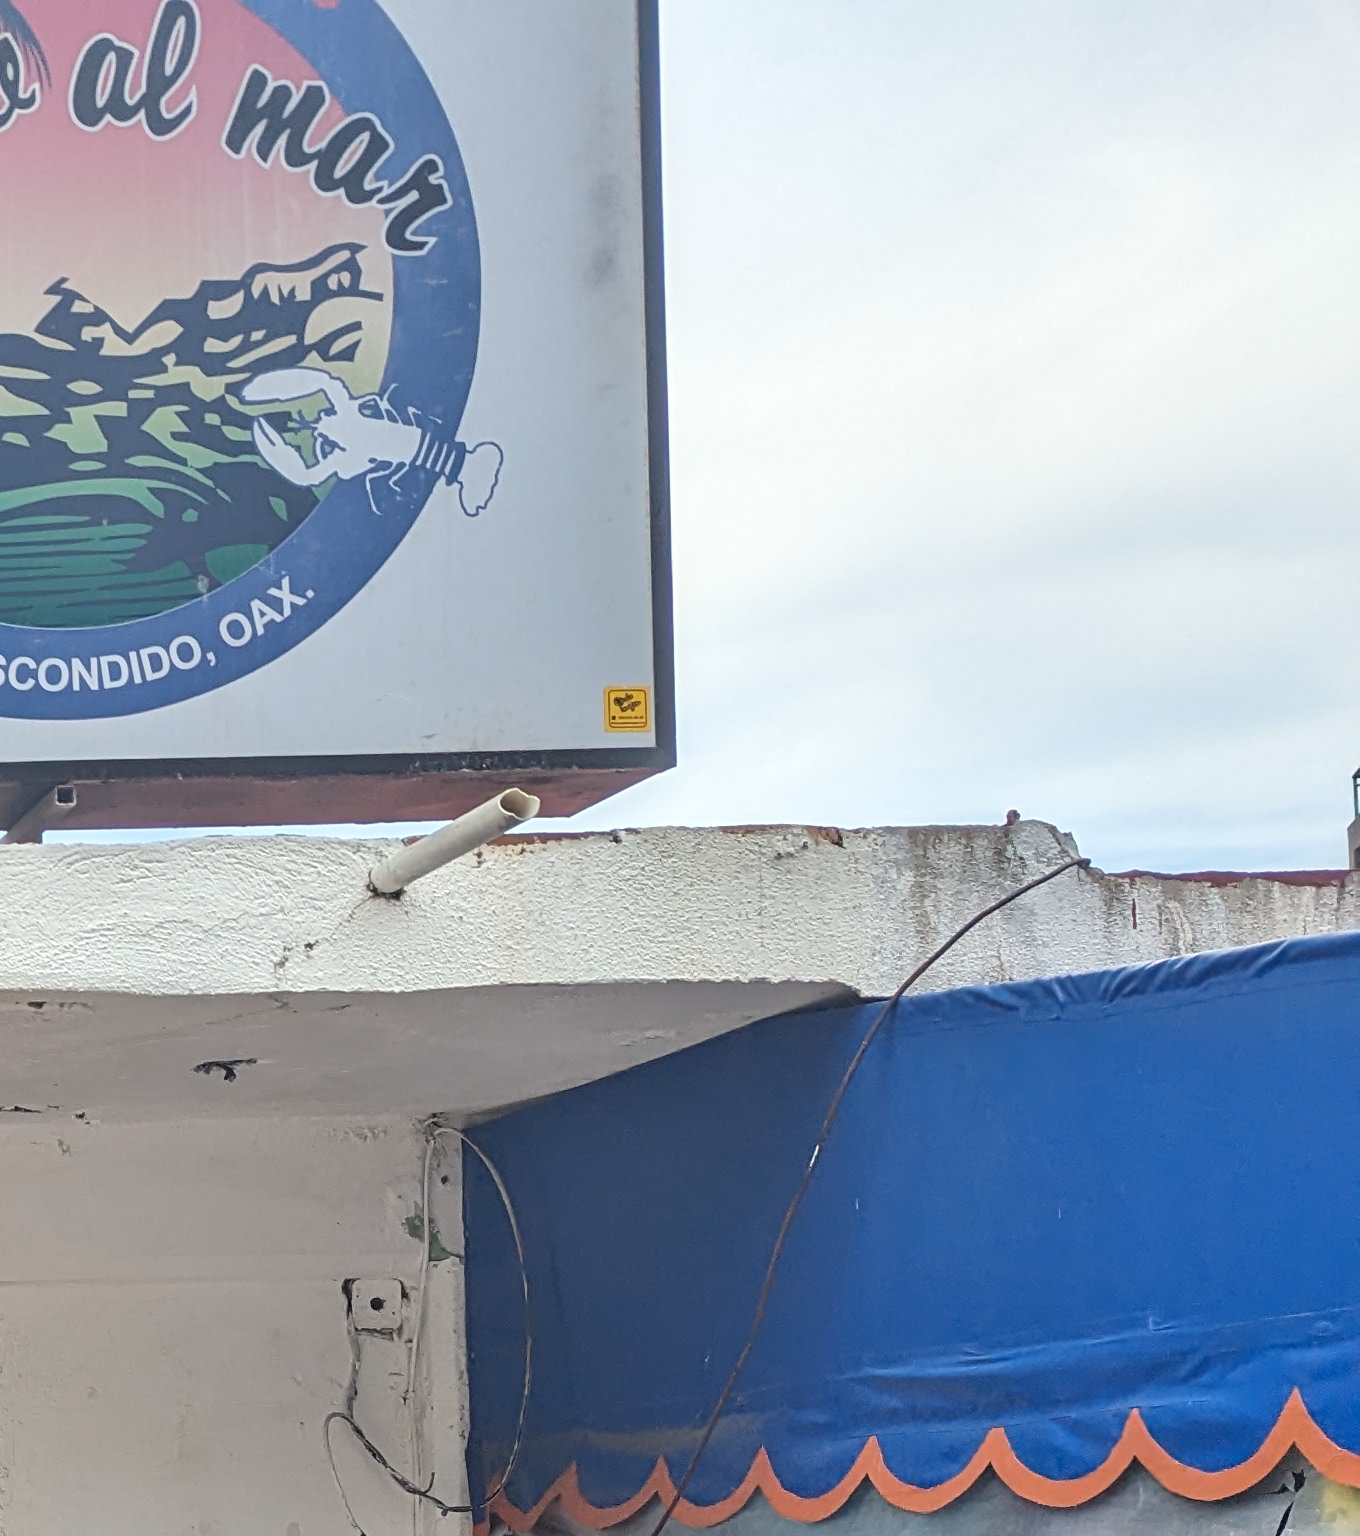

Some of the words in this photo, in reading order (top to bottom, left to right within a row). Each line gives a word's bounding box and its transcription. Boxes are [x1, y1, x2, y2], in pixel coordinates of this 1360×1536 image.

[70, 0, 198, 140] al
[223, 63, 457, 257] mar
[218, 575, 317, 648] OAX.
